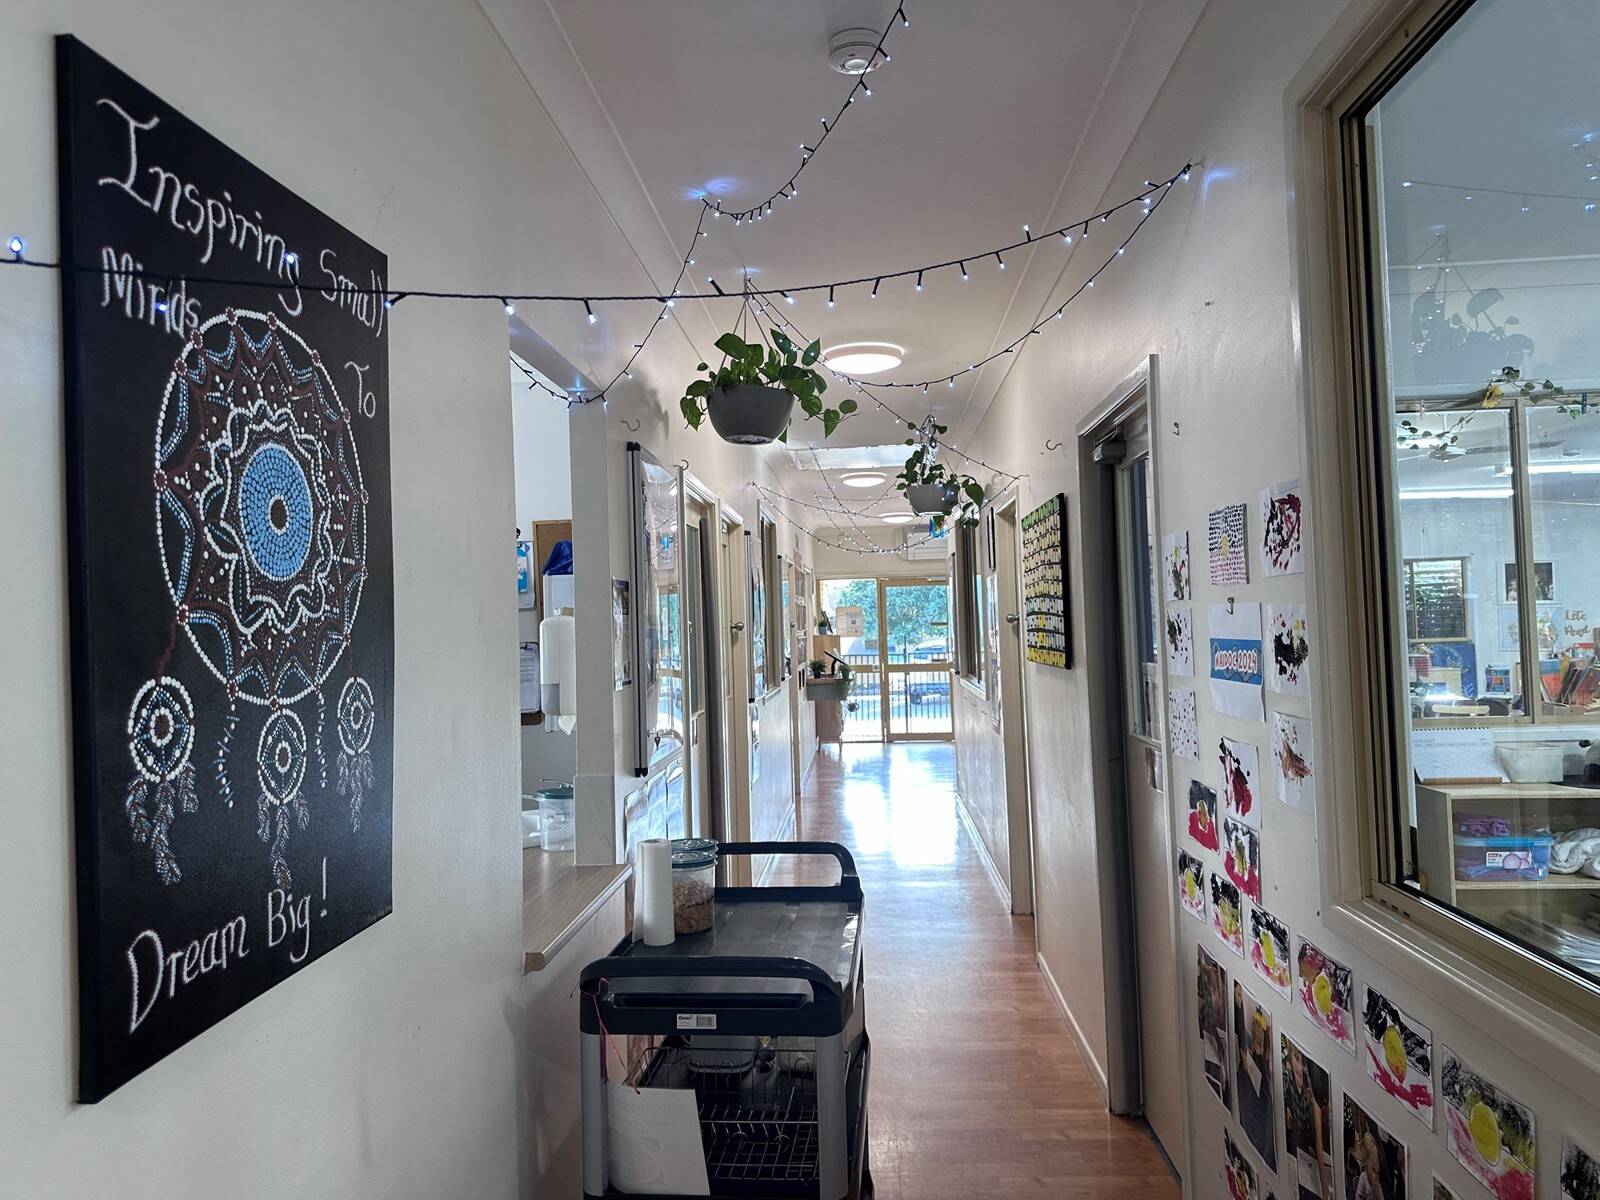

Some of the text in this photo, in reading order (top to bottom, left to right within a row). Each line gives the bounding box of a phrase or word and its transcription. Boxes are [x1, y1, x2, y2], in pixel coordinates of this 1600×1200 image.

[97, 98, 385, 337] Inspiring Small
[344, 361, 377, 418] To
[127, 915, 250, 1035] Dream
